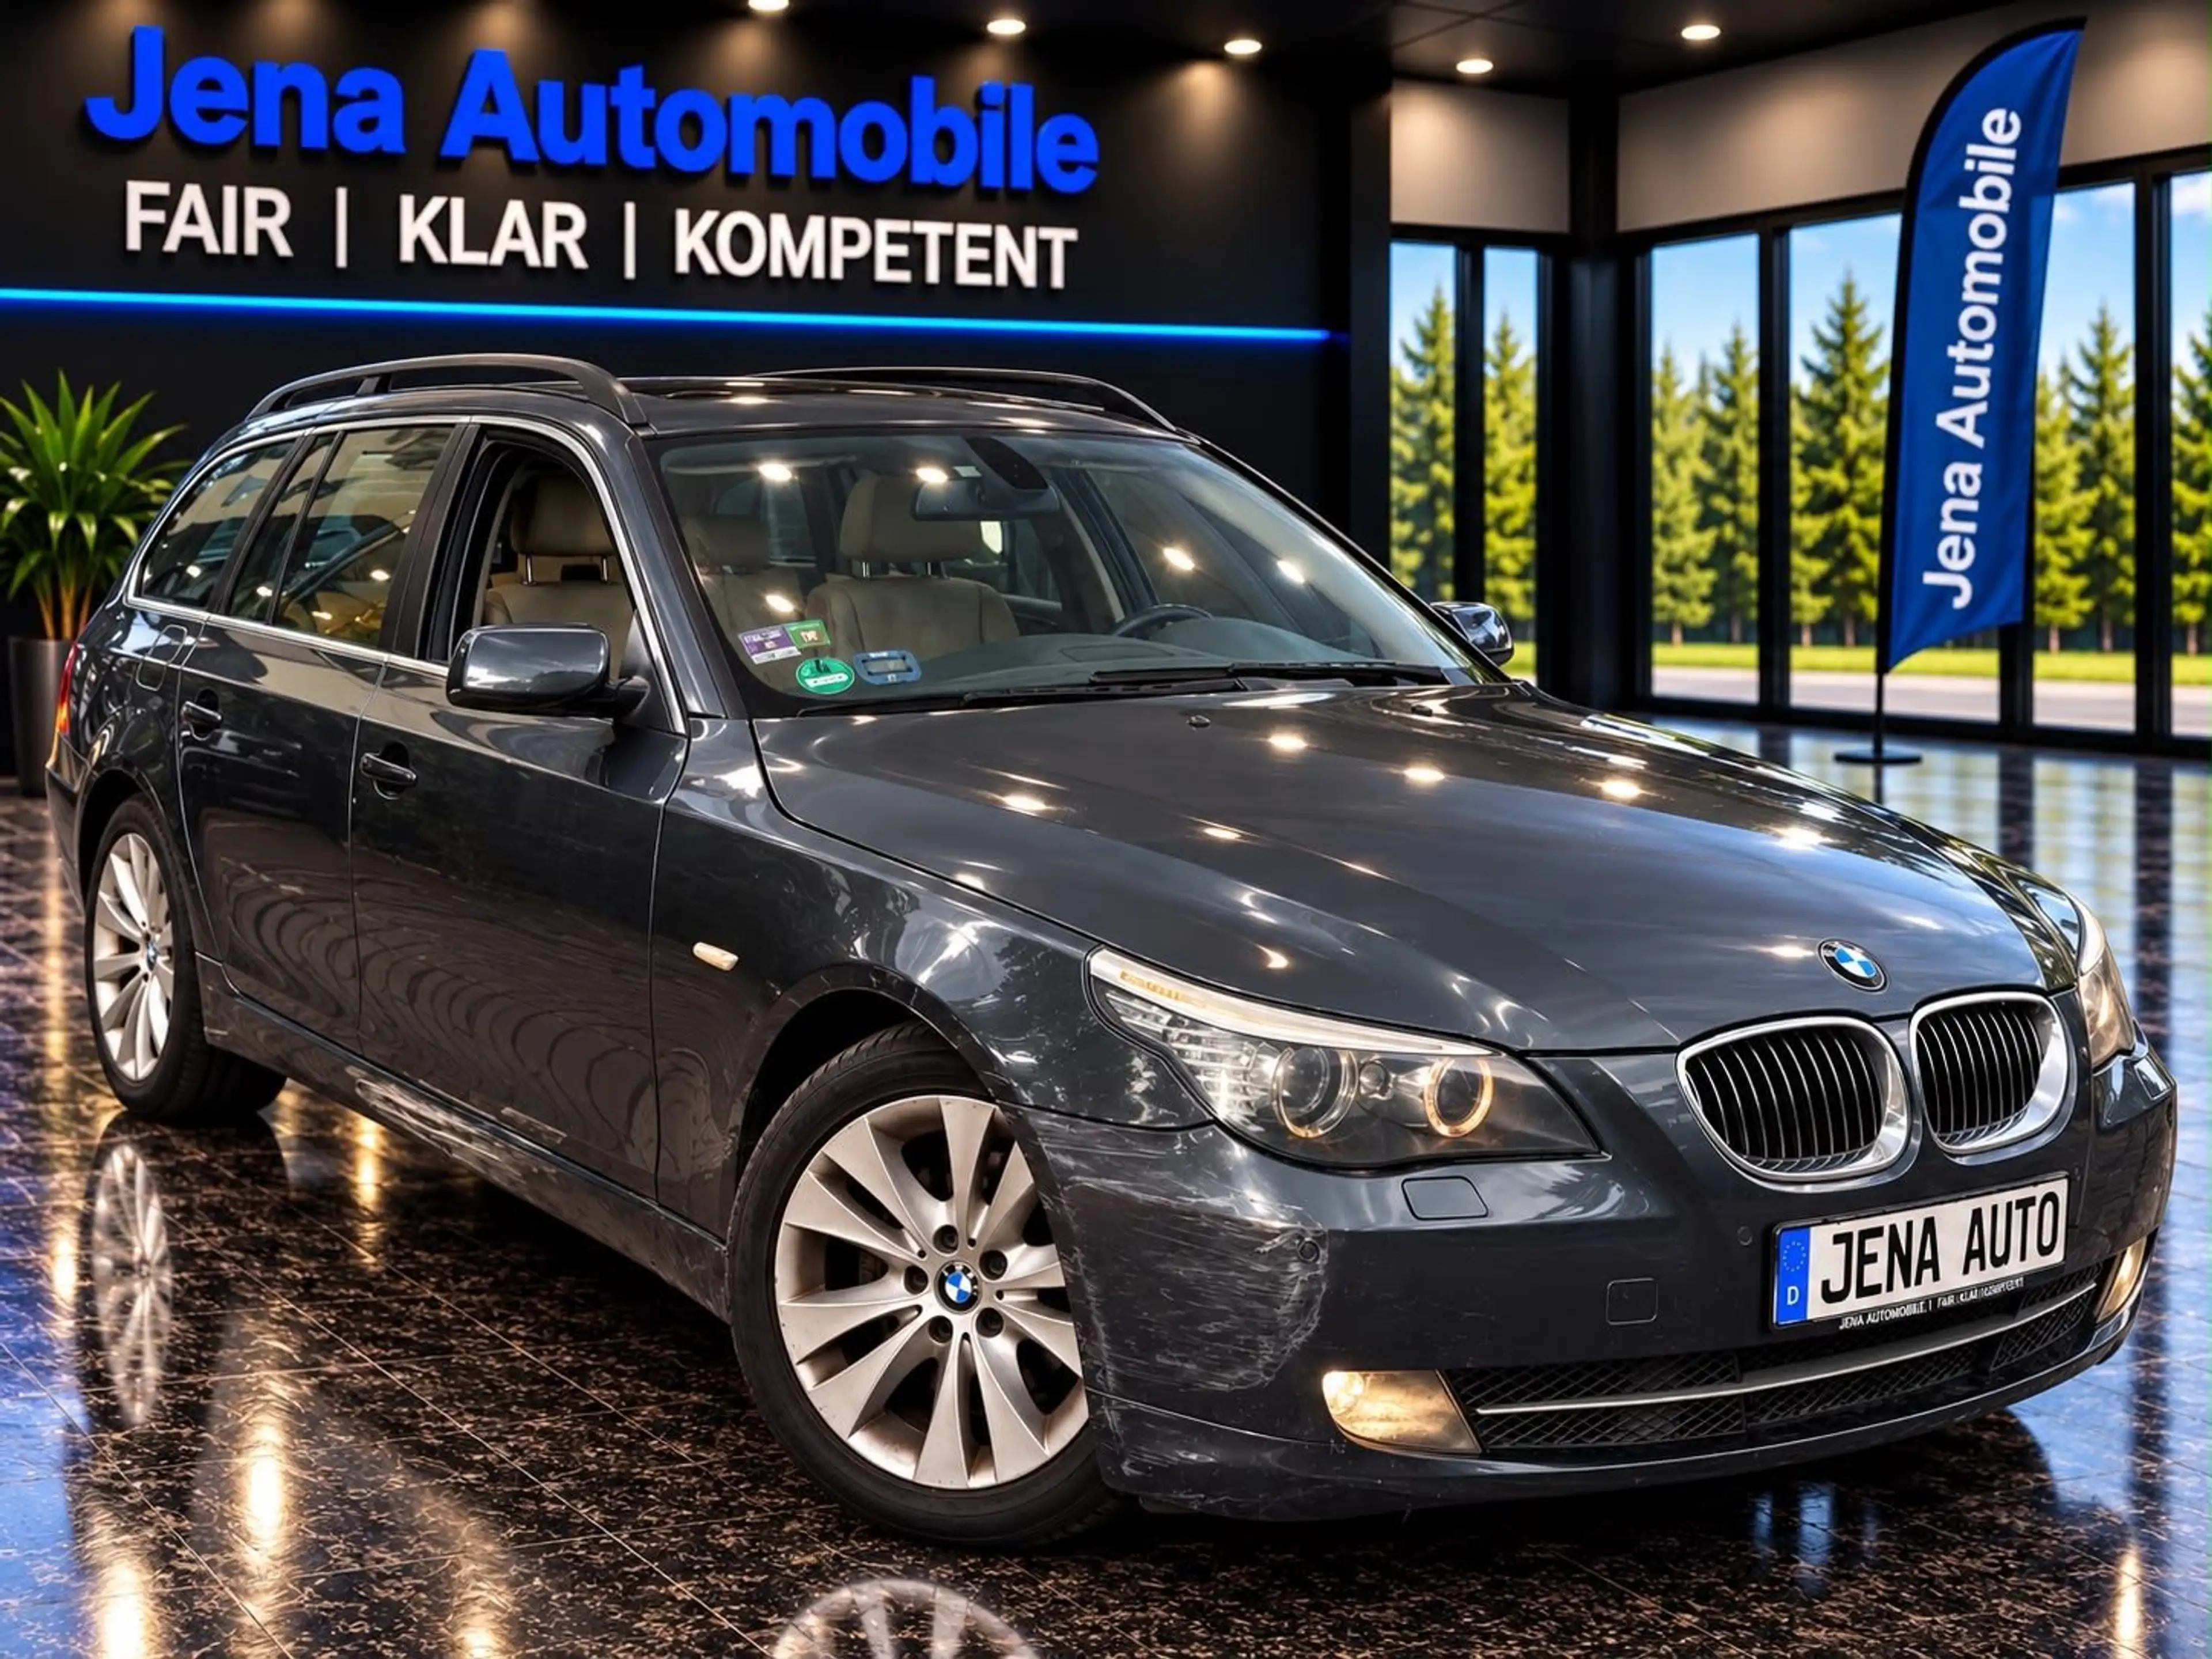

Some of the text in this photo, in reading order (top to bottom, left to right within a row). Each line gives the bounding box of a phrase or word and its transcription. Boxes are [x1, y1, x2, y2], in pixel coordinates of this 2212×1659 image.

[85, 25, 1100, 194] Jena Automobile
[125, 180, 294, 258] FAIR
[399, 194, 589, 270] KLAR
[675, 208, 1079, 289] KOMPETENT
[1923, 108, 2021, 609] Jena Automobile
[1787, 1286, 1800, 1305] D
[1821, 1191, 2060, 1305] JENA AUTO
